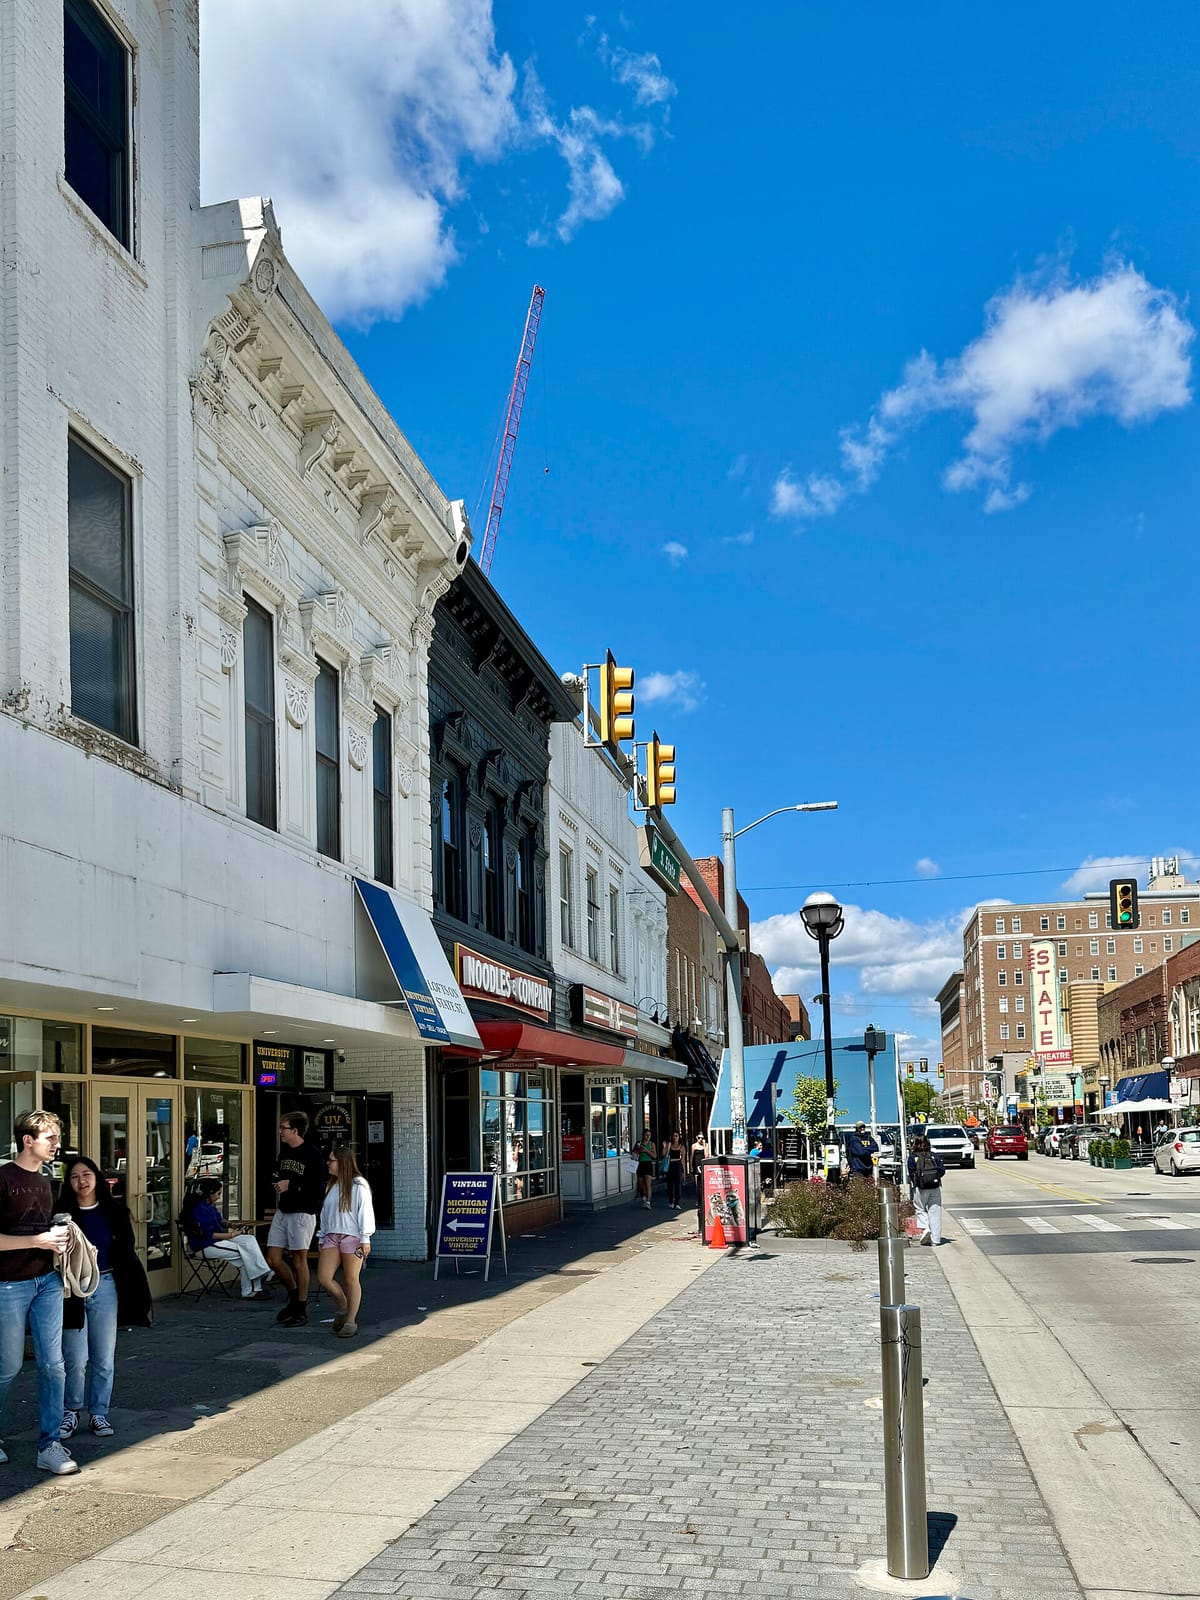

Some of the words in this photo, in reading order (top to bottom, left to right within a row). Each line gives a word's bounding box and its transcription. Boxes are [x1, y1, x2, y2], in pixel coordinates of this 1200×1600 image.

[665, 855, 676, 880] State
[427, 979, 450, 996] LOFTS
[463, 955, 511, 998] NOODLES
[516, 976, 553, 1012] COMPANY
[1036, 949, 1053, 1046] STATE
[435, 997, 454, 1012] STATE
[257, 1046, 290, 1059] UNIVERSITY
[1037, 1051, 1071, 1060] THEATRE
[262, 1060, 286, 1071] VINTAGE
[324, 1115, 342, 1125] UV
[452, 1180, 488, 1188] VINTAGE
[446, 1199, 489, 1207] MICHIGAN
[446, 1207, 487, 1215] CLOTHING
